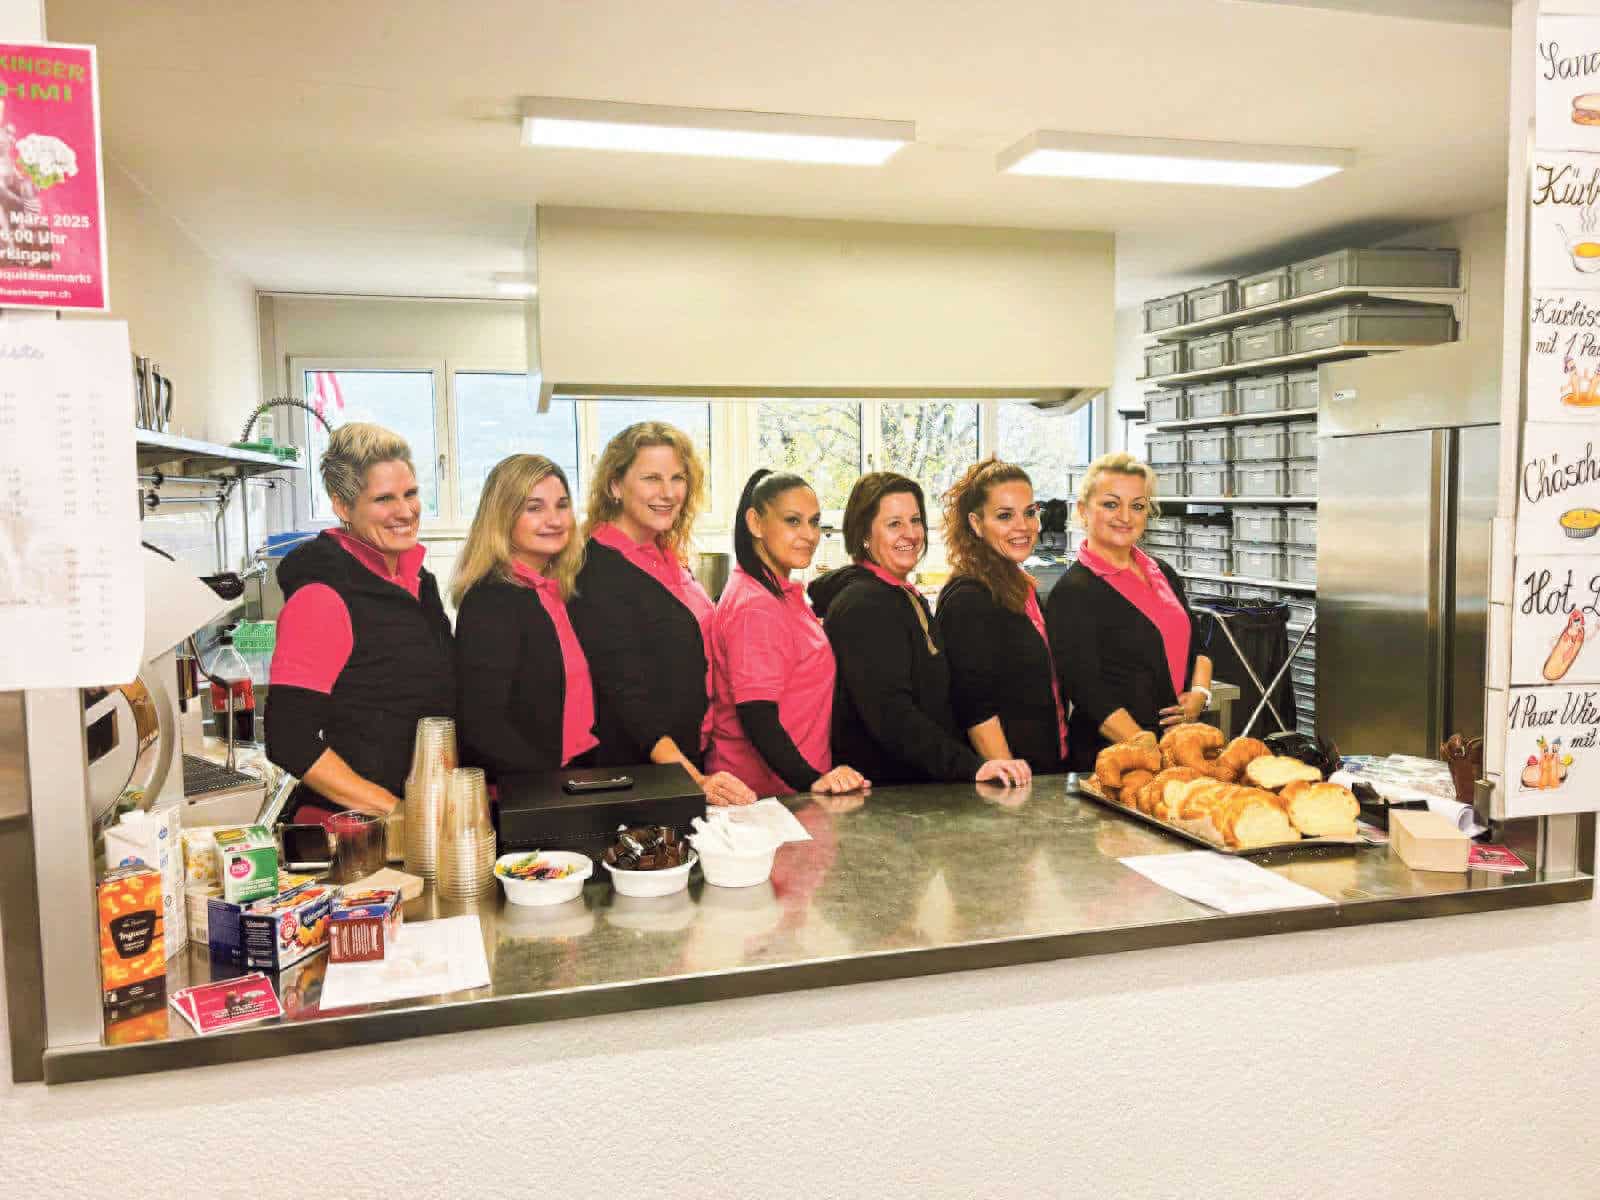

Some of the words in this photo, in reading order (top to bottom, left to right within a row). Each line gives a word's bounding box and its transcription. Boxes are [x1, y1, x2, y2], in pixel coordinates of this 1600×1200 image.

[53, 214, 90, 229] 2025
[38, 231, 67, 244] Uhr
[1524, 442, 1600, 504] Chäsch
[1521, 569, 1576, 615] Hot
[1521, 694, 1558, 728] Paar
[1560, 691, 1600, 725] Wie
[1570, 727, 1596, 748] mit
